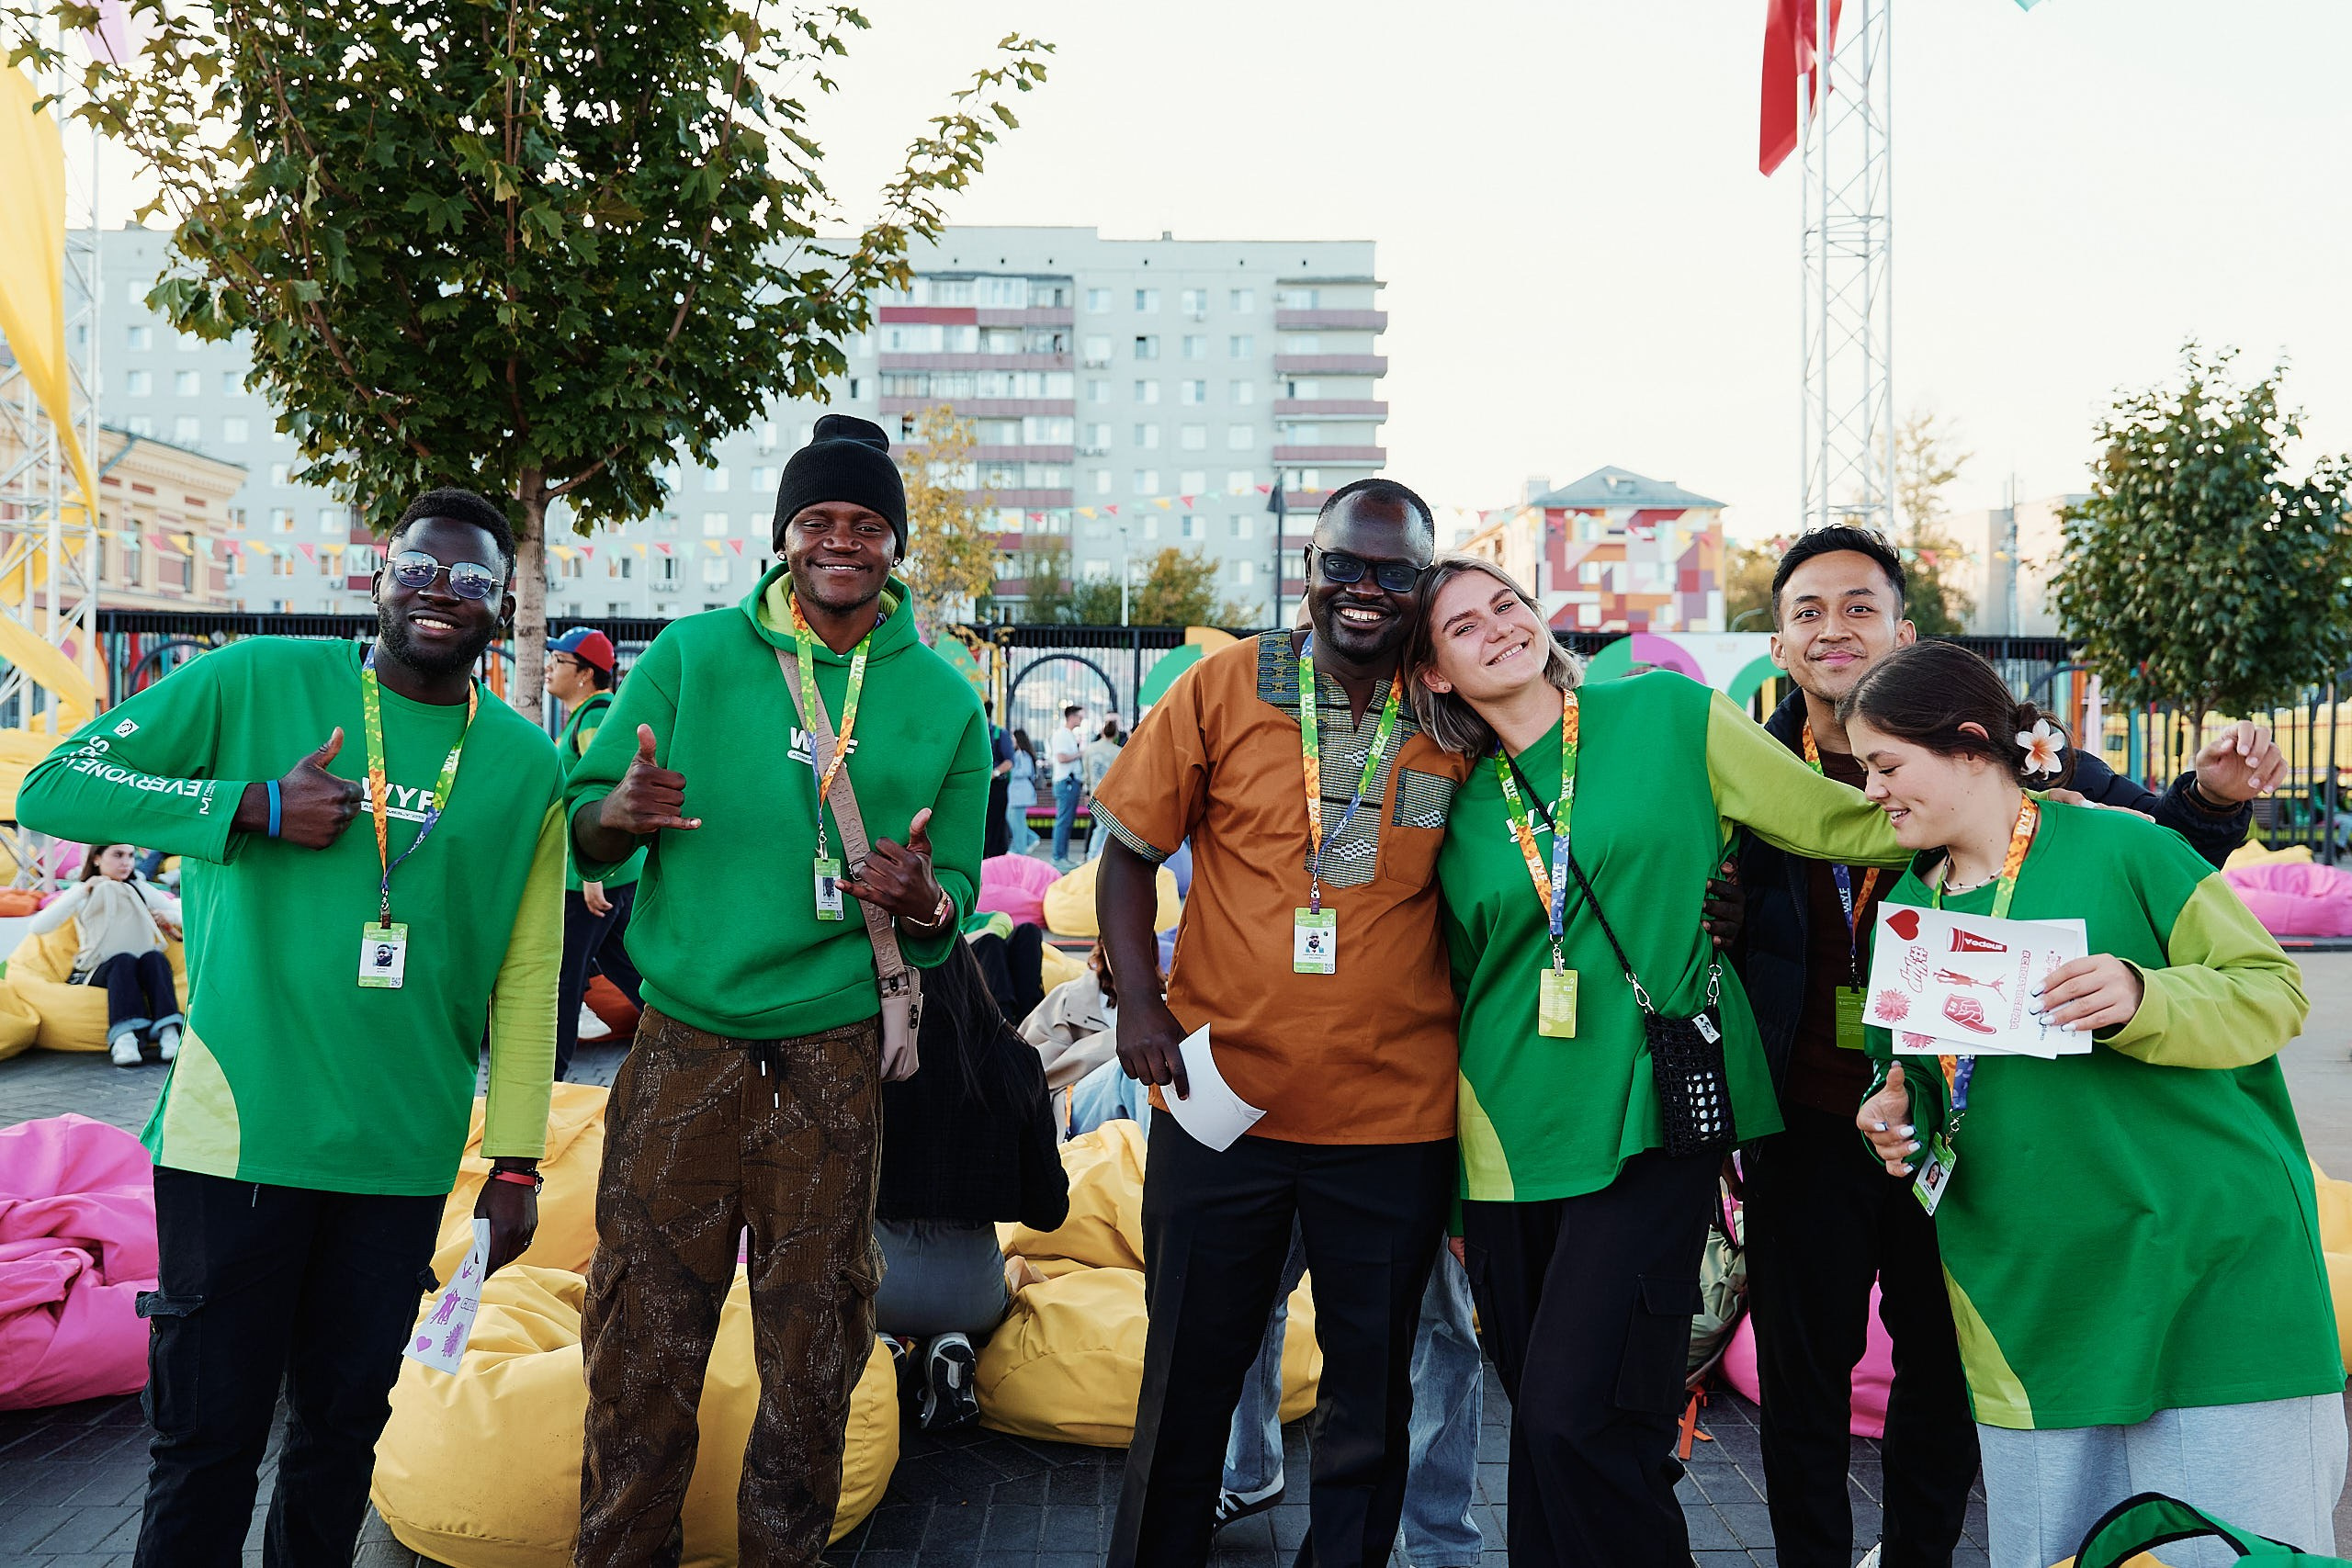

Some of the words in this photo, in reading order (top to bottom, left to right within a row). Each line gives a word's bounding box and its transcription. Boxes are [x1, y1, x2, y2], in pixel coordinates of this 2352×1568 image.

[854, 655, 866, 680] WYF
[1306, 693, 1316, 718] WYF
[1372, 731, 1385, 756] WYF
[73, 758, 203, 797] EVERYONE
[1505, 776, 1519, 798] WYF
[1561, 777, 1570, 800] WYF
[1312, 798, 1320, 823] WYF
[2016, 808, 2031, 835] WYF
[1532, 858, 1548, 882] WYF
[1551, 863, 1562, 893] WYF
[1838, 887, 1850, 912] WYF
